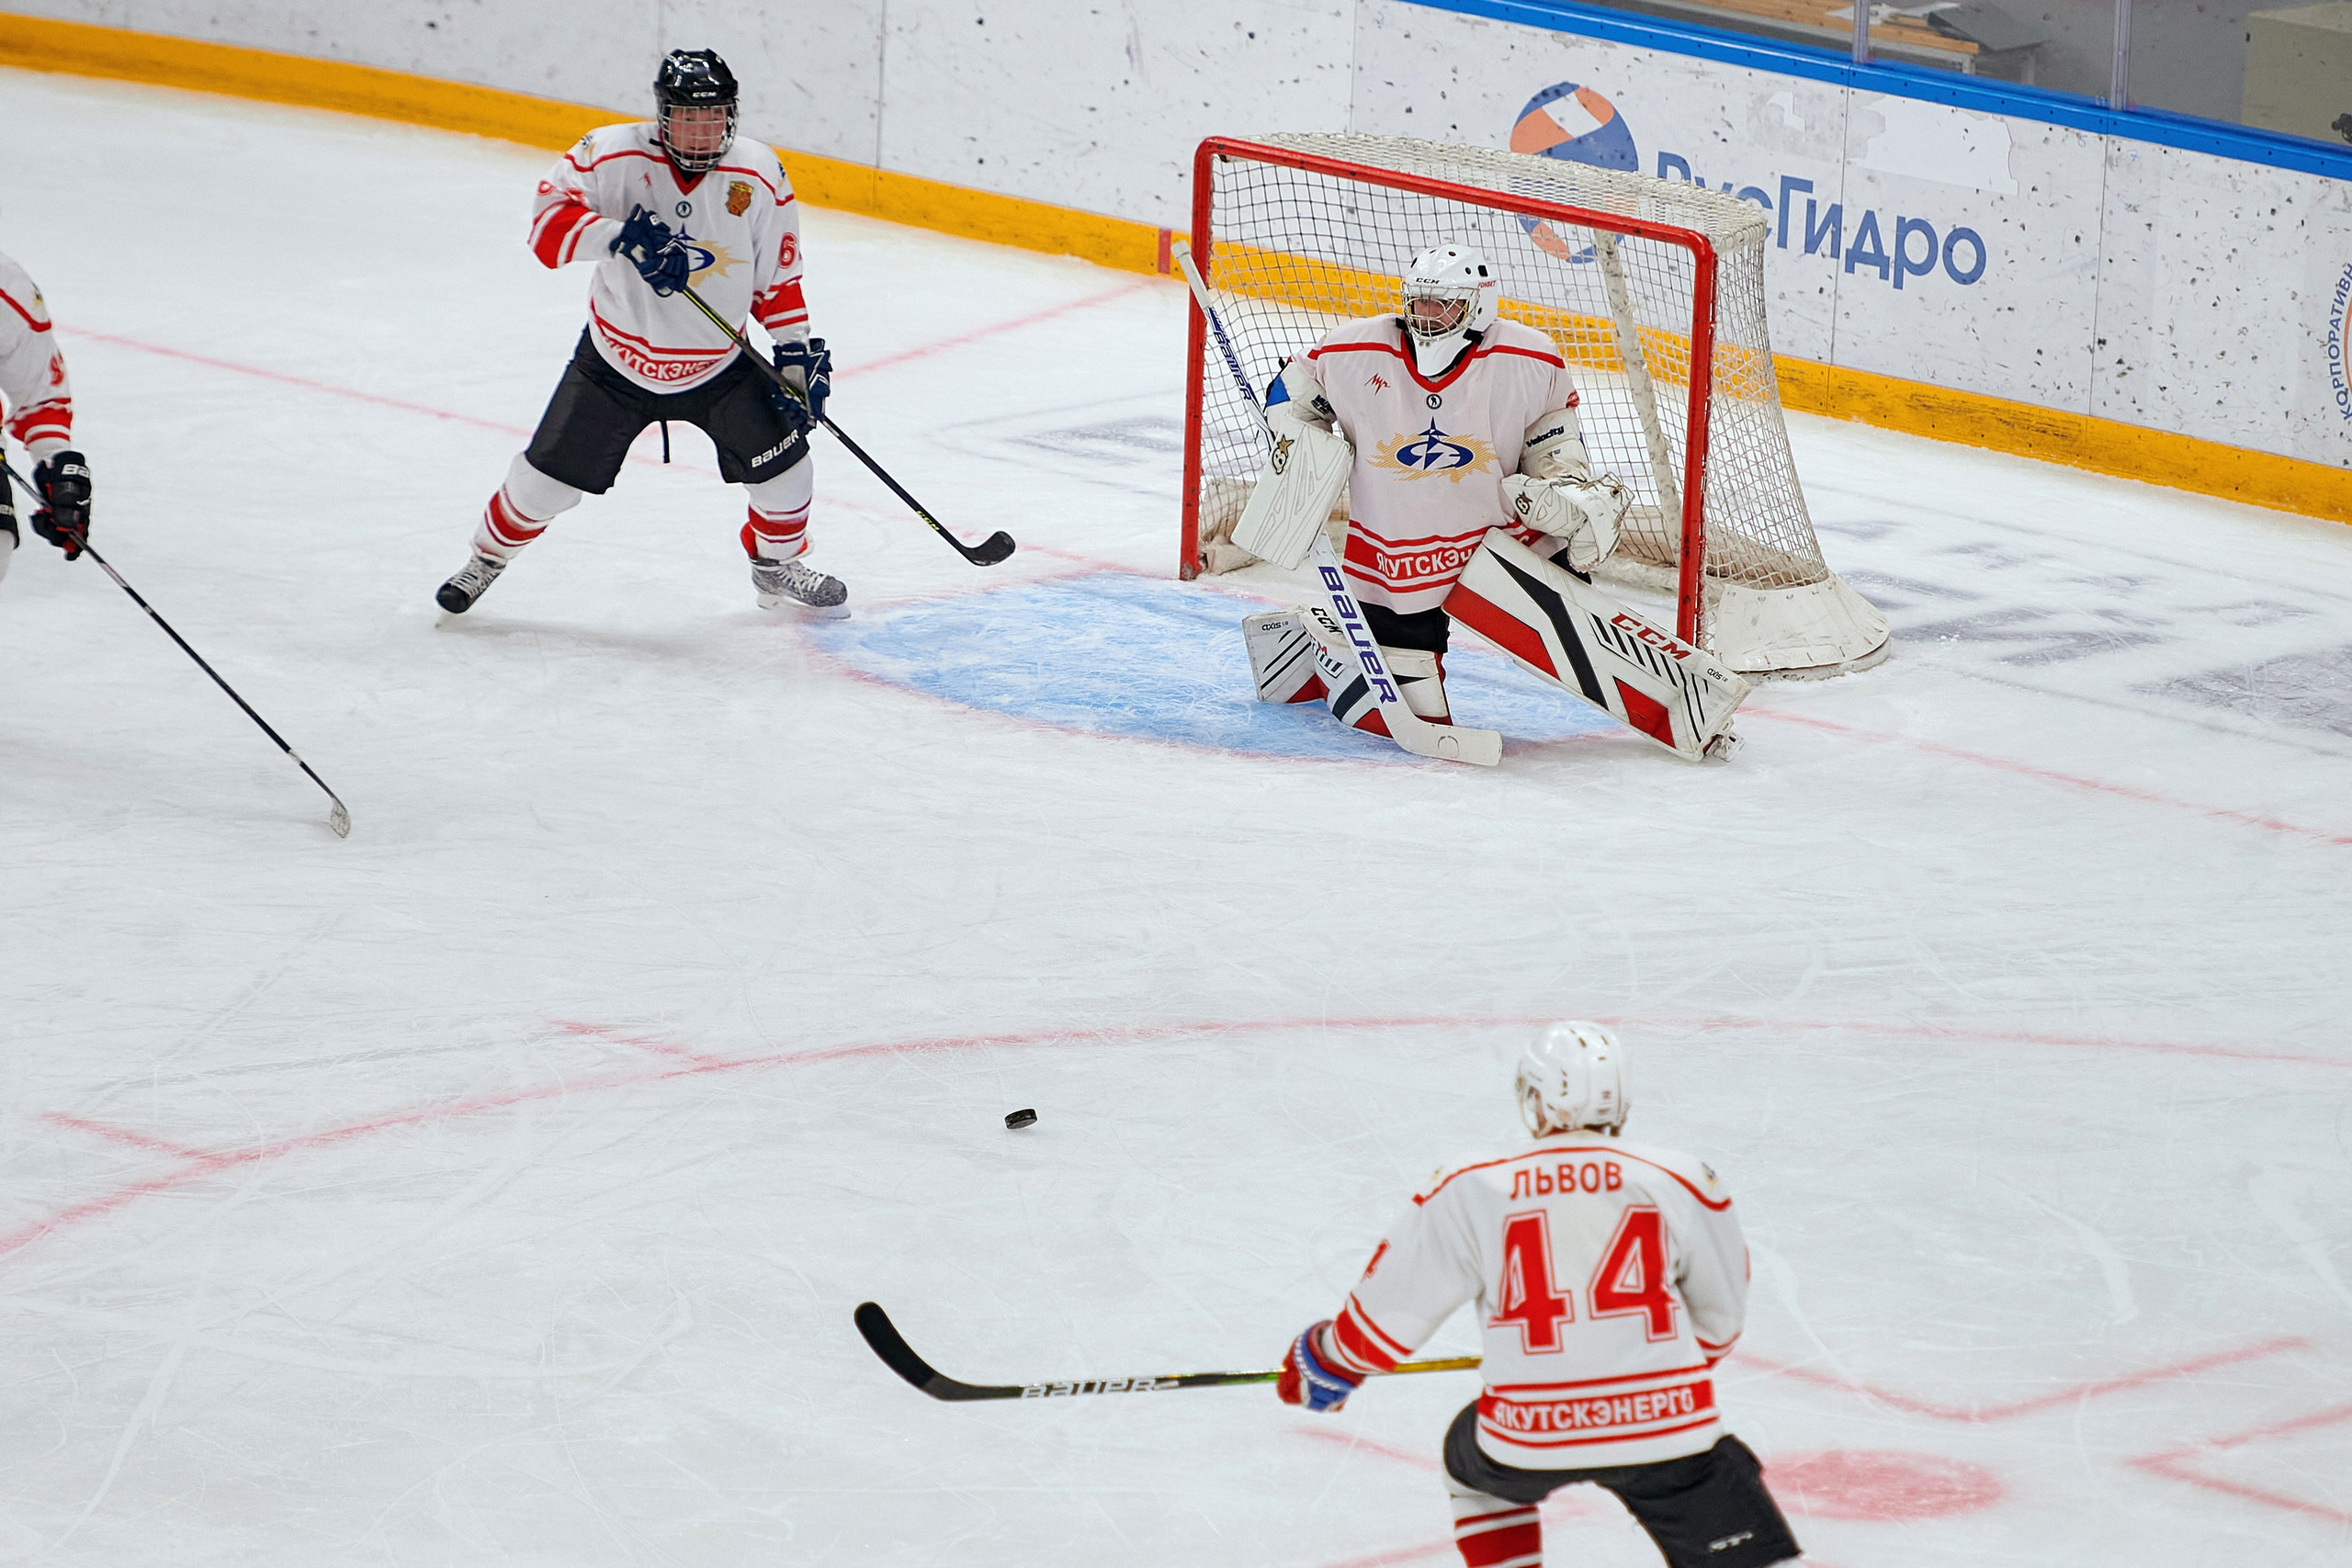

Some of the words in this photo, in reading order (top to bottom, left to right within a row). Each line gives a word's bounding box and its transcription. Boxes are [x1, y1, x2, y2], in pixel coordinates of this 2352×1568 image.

[777, 231, 802, 270] 6
[751, 428, 800, 468] BAUER
[1525, 424, 1565, 448] Velocity
[916, 510, 941, 530] CCM
[1310, 607, 1343, 634] CCM
[1317, 566, 1398, 705] BAUER
[1611, 612, 1692, 660] CCM
[1510, 1161, 1623, 1201] ЛЬВОВ
[1487, 1204, 1680, 1355] 44
[1493, 1386, 1695, 1431] ЯКУТСКЭНЕРГО
